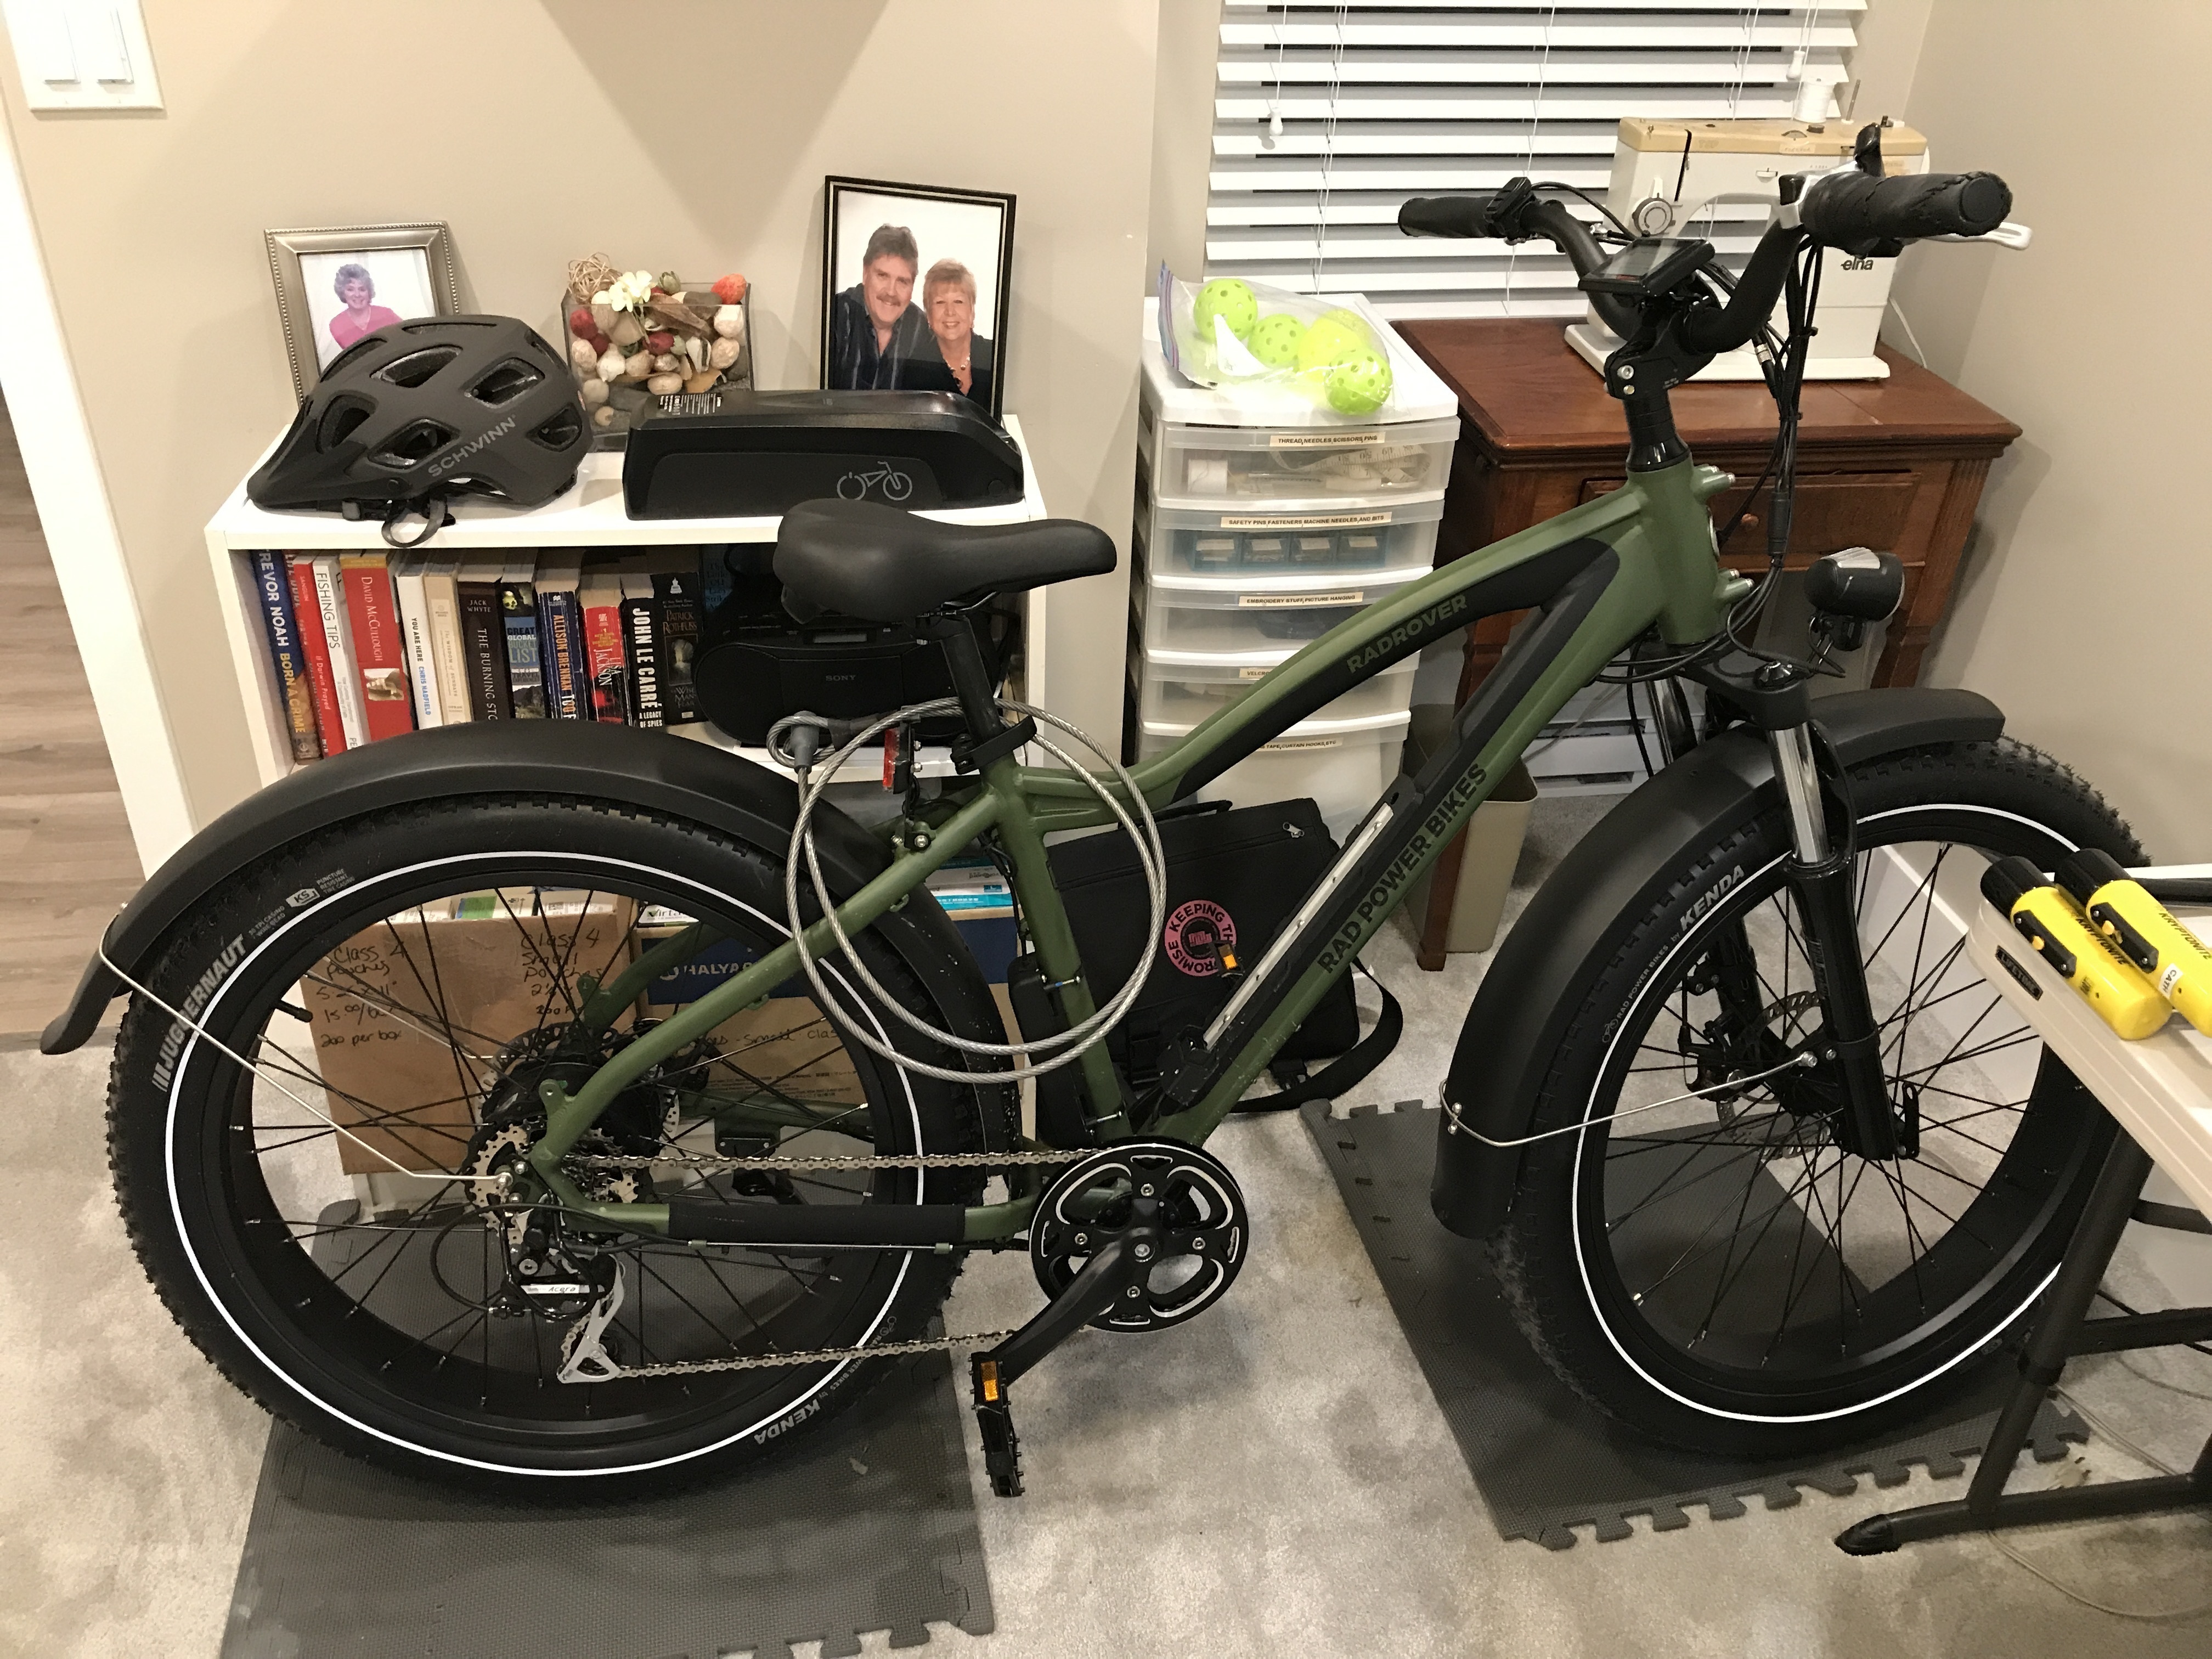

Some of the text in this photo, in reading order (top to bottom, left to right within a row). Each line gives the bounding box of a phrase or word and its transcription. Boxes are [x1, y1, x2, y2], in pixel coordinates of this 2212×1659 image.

[1841, 257, 1874, 271] elna
[427, 417, 516, 477] SCHWINN
[259, 549, 289, 646] REVOR NOAH
[361, 577, 374, 603] DAVID
[317, 573, 340, 648] FISHING TIPS
[663, 622, 697, 634] ROTHFUSS
[666, 610, 693, 621] PATRICK
[477, 628, 489, 650] THE
[507, 627, 535, 635] GREAT
[553, 615, 568, 650] ALLISON
[1346, 595, 1467, 673] RADROVER
[509, 648, 537, 663] LIST
[557, 652, 572, 691] BRENNAN
[594, 648, 612, 686] JACKSON
[610, 657, 622, 675] LISA
[633, 608, 662, 709] JOHN LE CARRÉ
[280, 653, 306, 733] BORN A CRIME
[317, 663, 325, 686] Darwin
[321, 688, 331, 710] Prayed
[481, 653, 495, 699] BURNING
[422, 686, 431, 715] HADFIELD
[644, 711, 662, 719] LEGACY
[1317, 763, 1487, 974] RAD POWER BIKES
[1680, 865, 1745, 932] KENDA
[1169, 903, 1225, 932] KEEPING
[586, 928, 600, 948] 4
[2075, 918, 2124, 964] KRYPTONITE
[2158, 912, 2212, 960] KRYPTONITE
[334, 946, 379, 963] Class
[1169, 940, 1217, 973] ROMISE
[1617, 932, 1680, 1019] RAD POWER BIKES by
[321, 1034, 345, 1047] 200
[352, 1033, 374, 1046] per
[754, 1399, 821, 1444] KENDA
